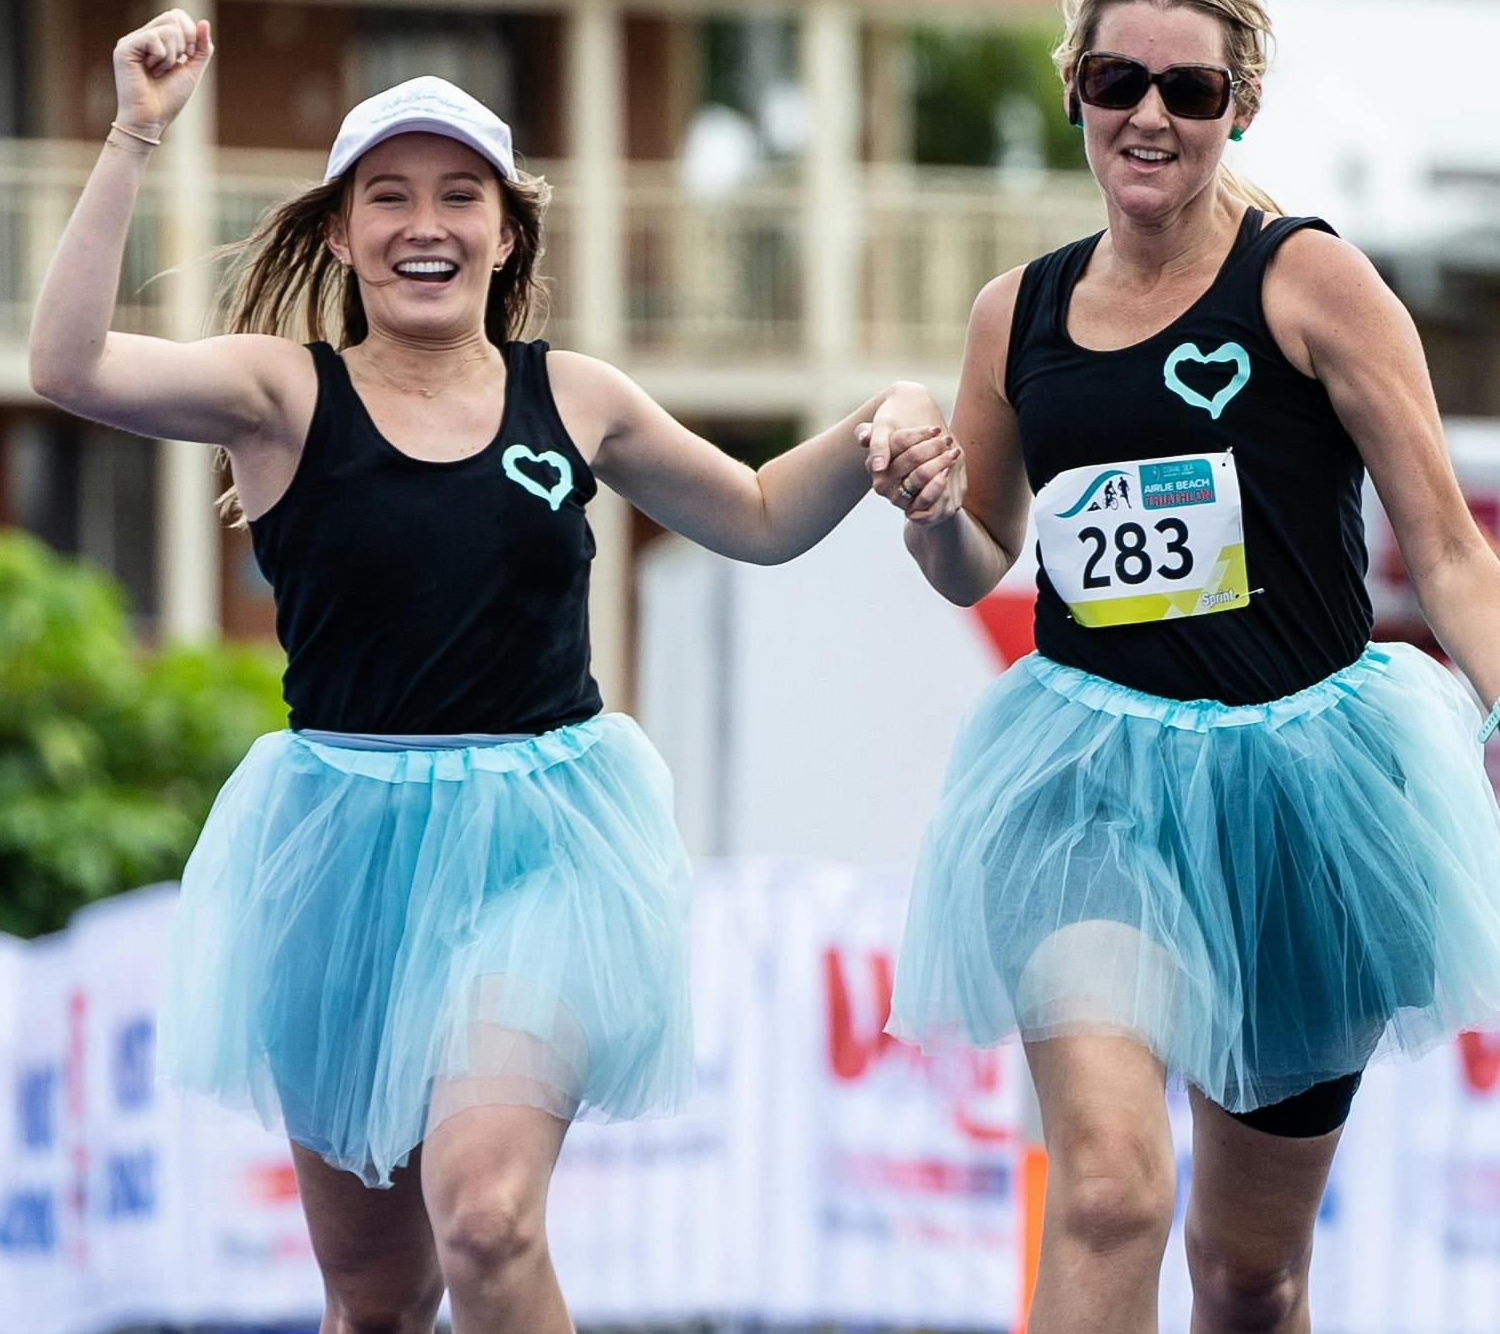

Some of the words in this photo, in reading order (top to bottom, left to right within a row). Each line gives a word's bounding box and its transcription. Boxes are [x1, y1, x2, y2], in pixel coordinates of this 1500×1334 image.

[1144, 481, 1174, 494] AIRLIE
[1175, 478, 1210, 491] BEACH
[1144, 489, 1212, 507] TRIATHLON
[1078, 517, 1194, 590] 283
[1201, 588, 1235, 610] Sprint
